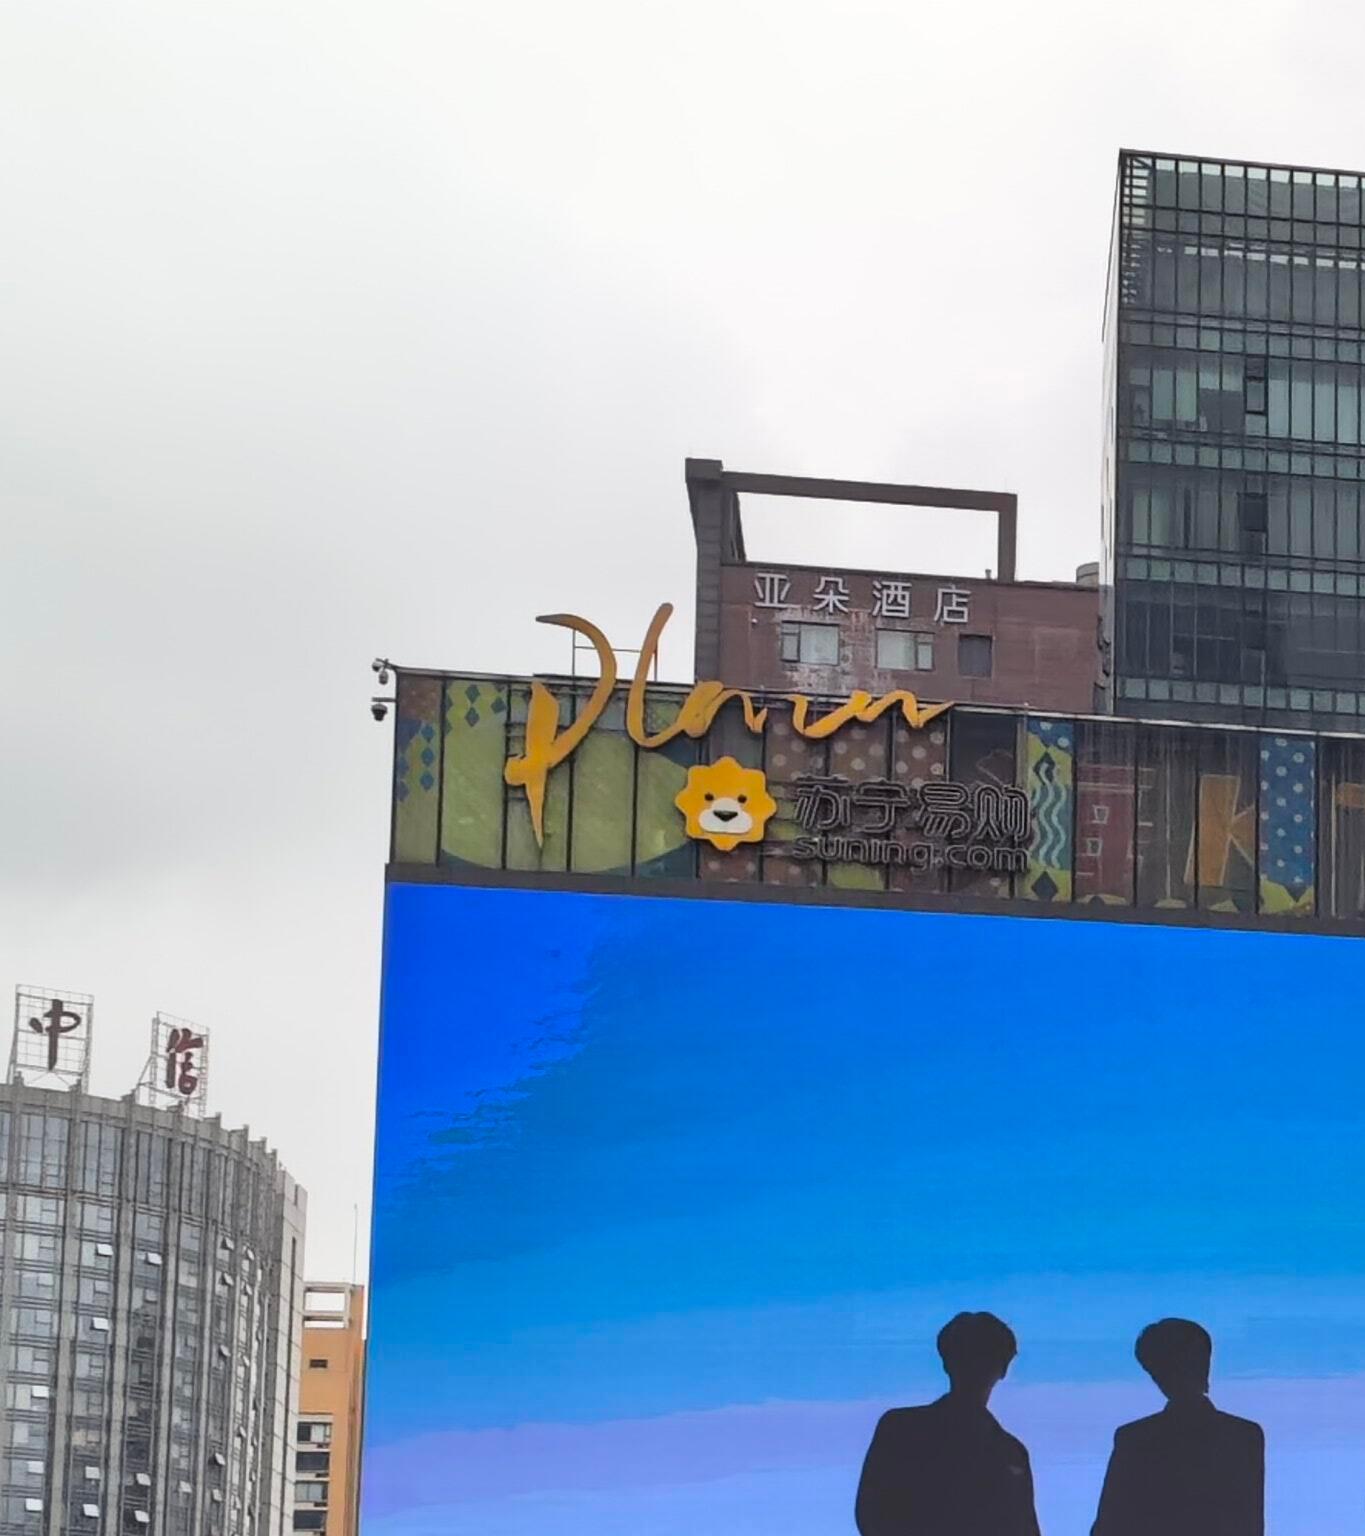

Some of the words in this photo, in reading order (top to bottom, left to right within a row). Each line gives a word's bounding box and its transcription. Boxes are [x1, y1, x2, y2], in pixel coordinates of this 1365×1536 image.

[754, 573, 971, 623] 亚朵酒店
[795, 777, 1031, 842] 苏宁易购
[792, 836, 1029, 872] suning.com
